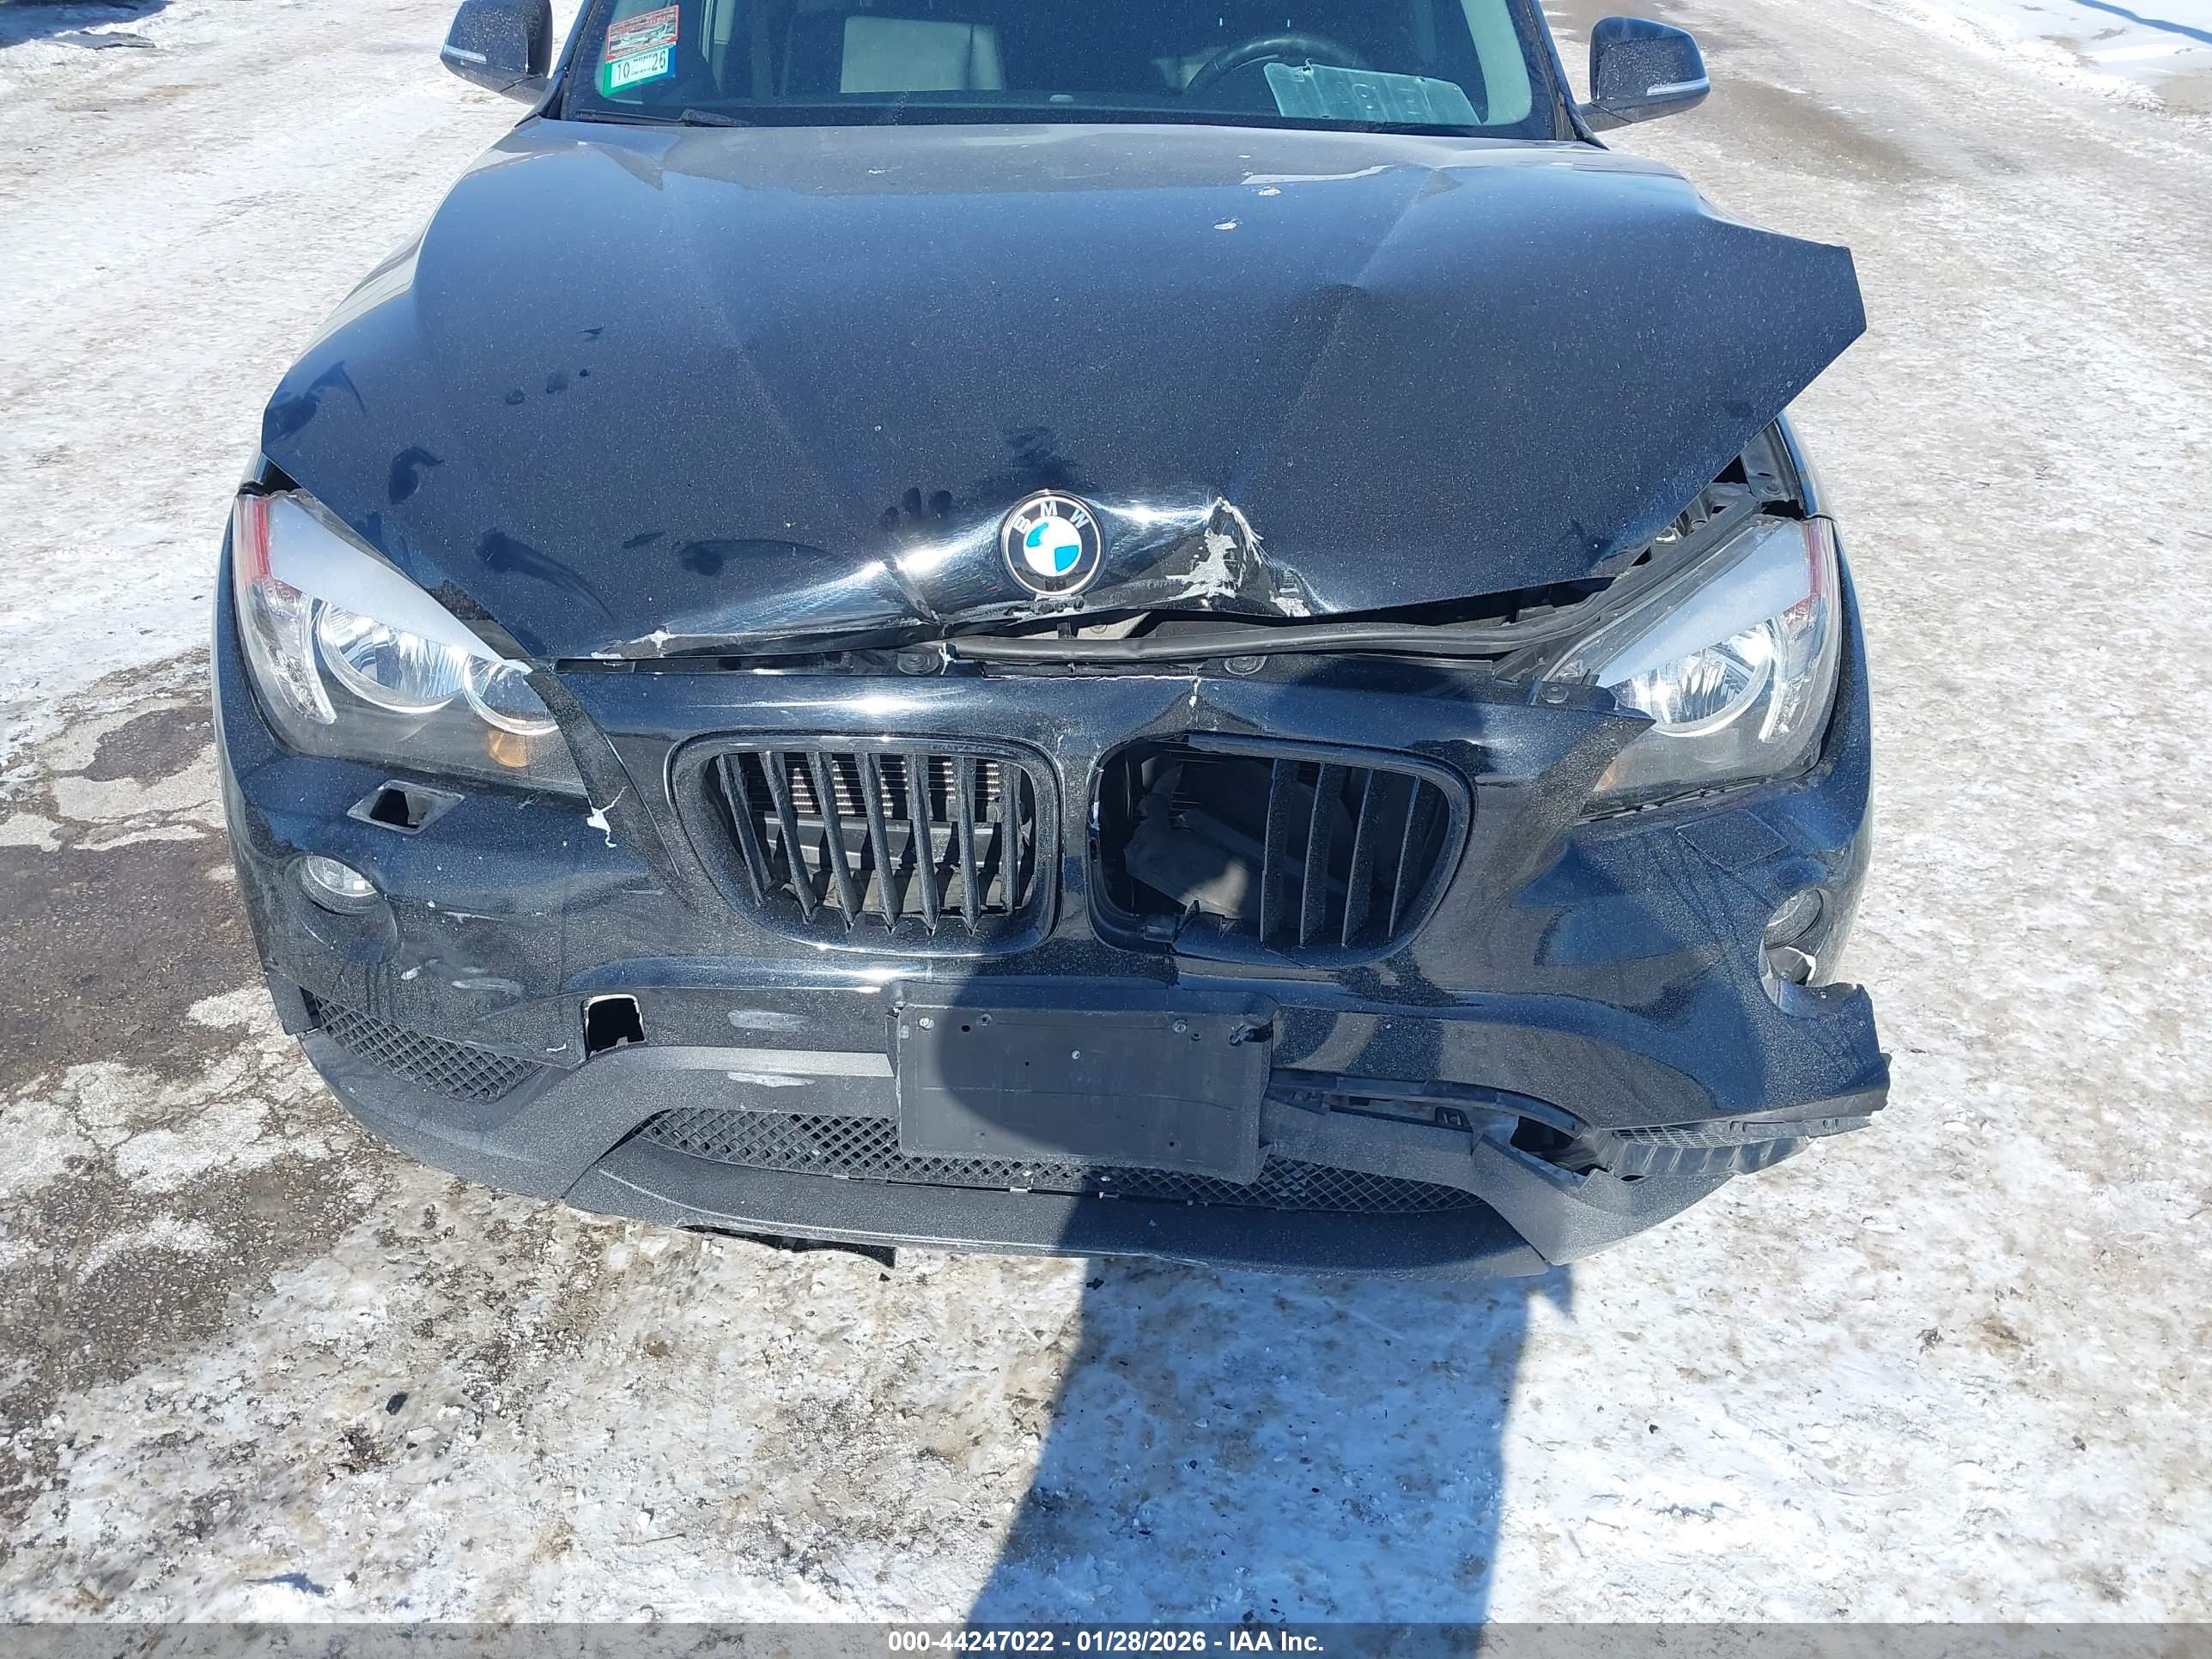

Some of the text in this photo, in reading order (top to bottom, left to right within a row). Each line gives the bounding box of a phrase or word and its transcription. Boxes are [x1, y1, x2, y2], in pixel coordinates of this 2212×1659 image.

[617, 62, 630, 81] 10
[652, 50, 666, 71] 26
[1013, 501, 1089, 534] BMW
